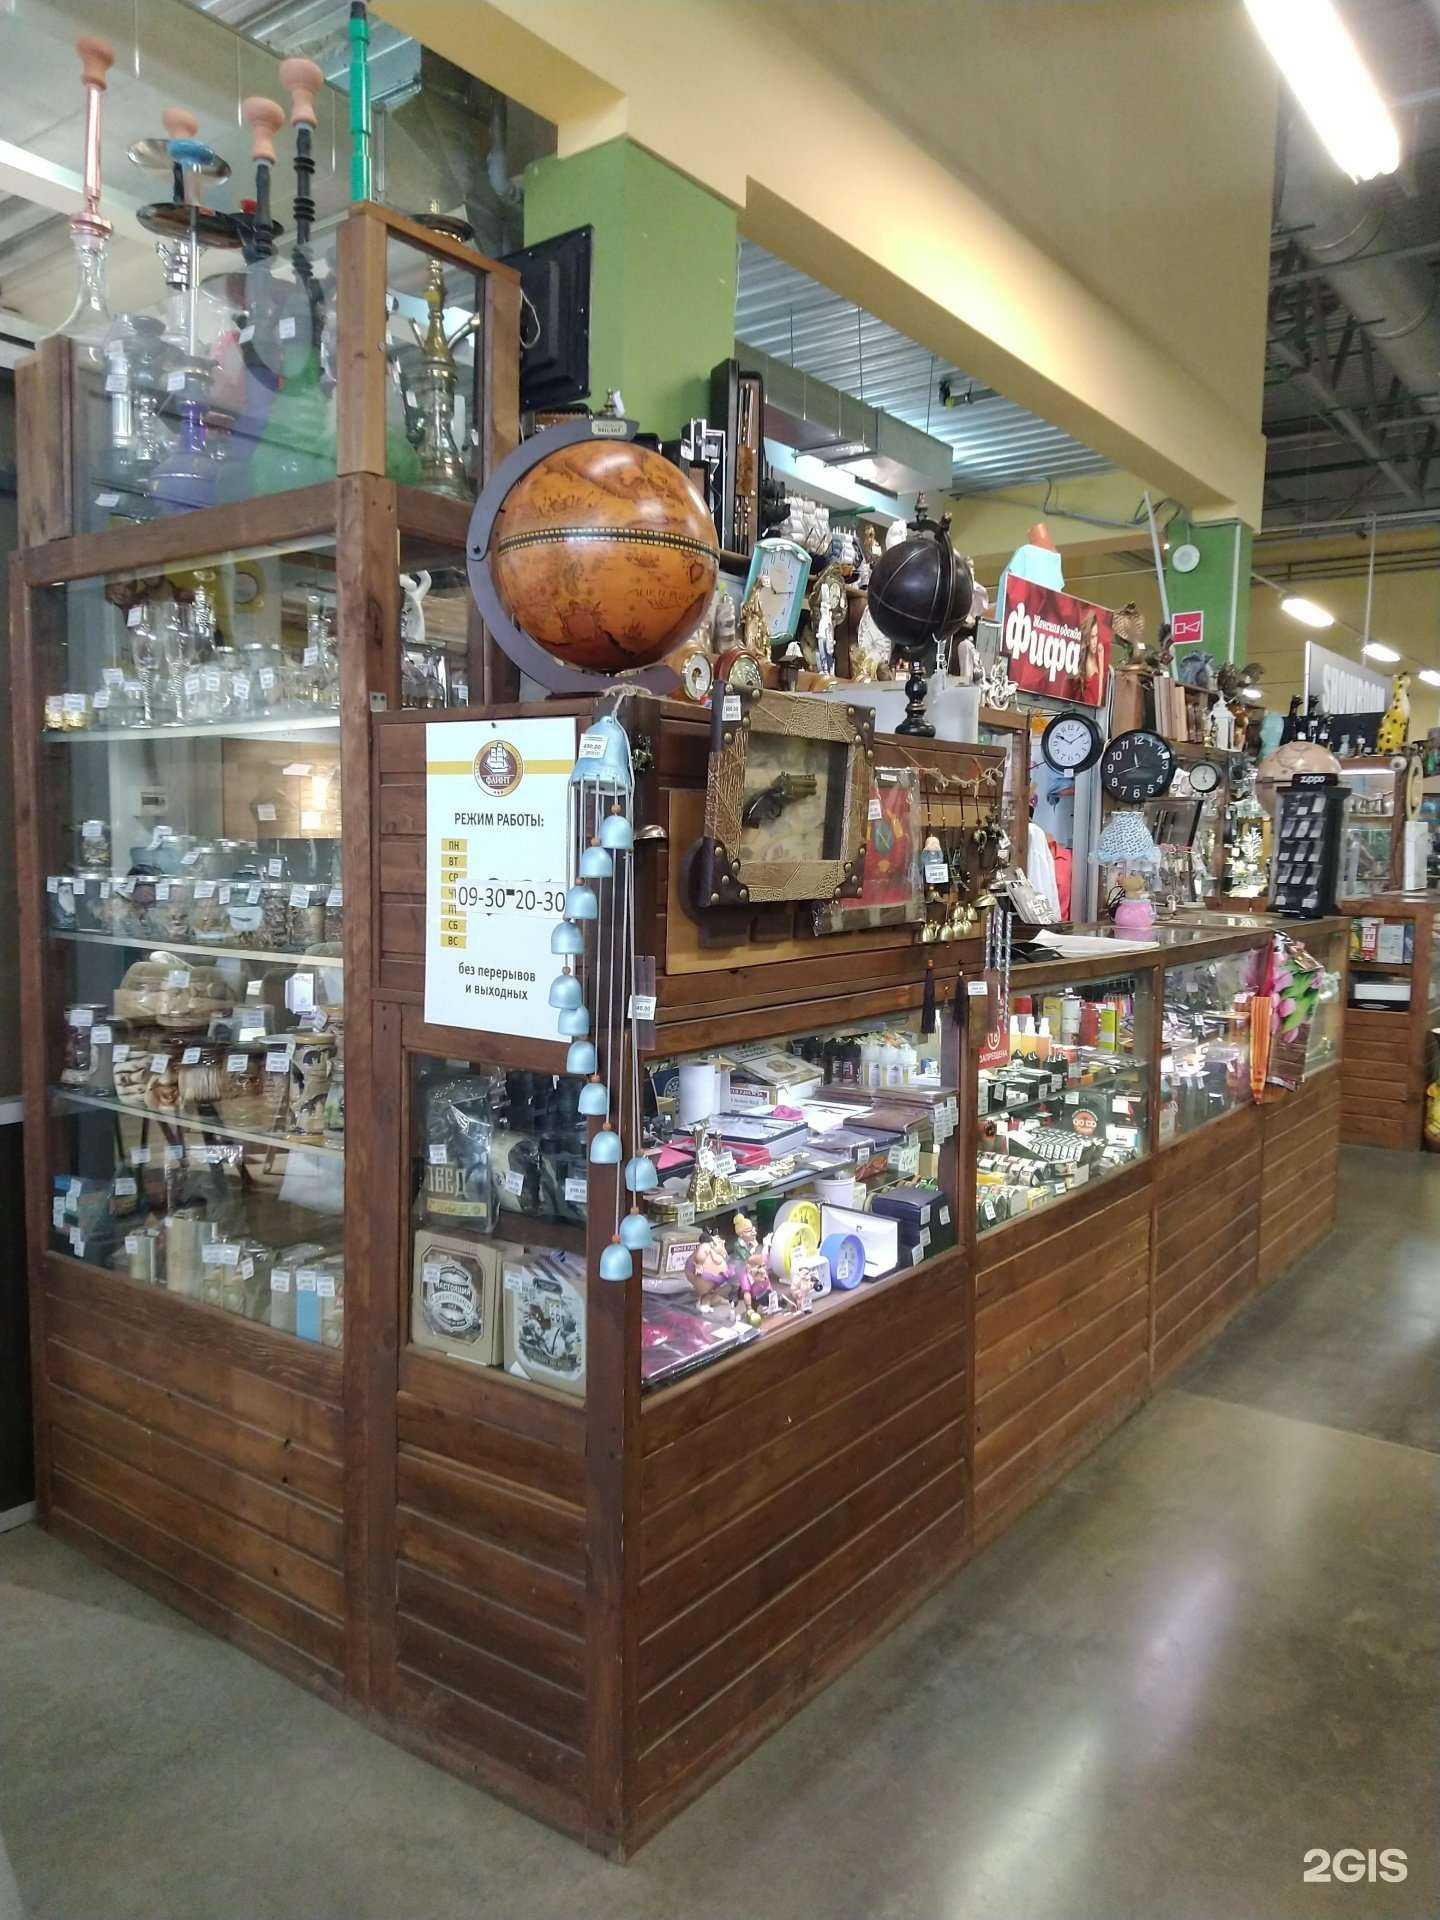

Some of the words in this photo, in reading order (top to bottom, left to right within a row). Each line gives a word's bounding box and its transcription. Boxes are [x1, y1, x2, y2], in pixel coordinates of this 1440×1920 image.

[1005, 601, 1081, 682] Фифа
[1121, 740, 1129, 750] 11
[1134, 735, 1144, 745] 12
[1111, 751, 1122, 761] 10
[1107, 764, 1114, 774] 9
[1161, 760, 1169, 770] 3
[1111, 777, 1118, 787] 8
[1156, 775, 1163, 784] 4
[1120, 786, 1127, 796] 7
[1133, 788, 1140, 798] 6
[1147, 784, 1155, 794] 5
[454, 811, 494, 827] РЕЖИМ
[496, 812, 545, 828] РАБОТЫ:
[448, 840, 460, 851] ПН
[448, 856, 459, 866] ВТ
[448, 872, 459, 882] СР
[448, 920, 458, 930] СБ
[448, 936, 459, 946] ВС
[458, 961, 475, 976] без
[478, 966, 536, 982] перерывов
[465, 984, 472, 993] и
[474, 985, 528, 1000] выходных
